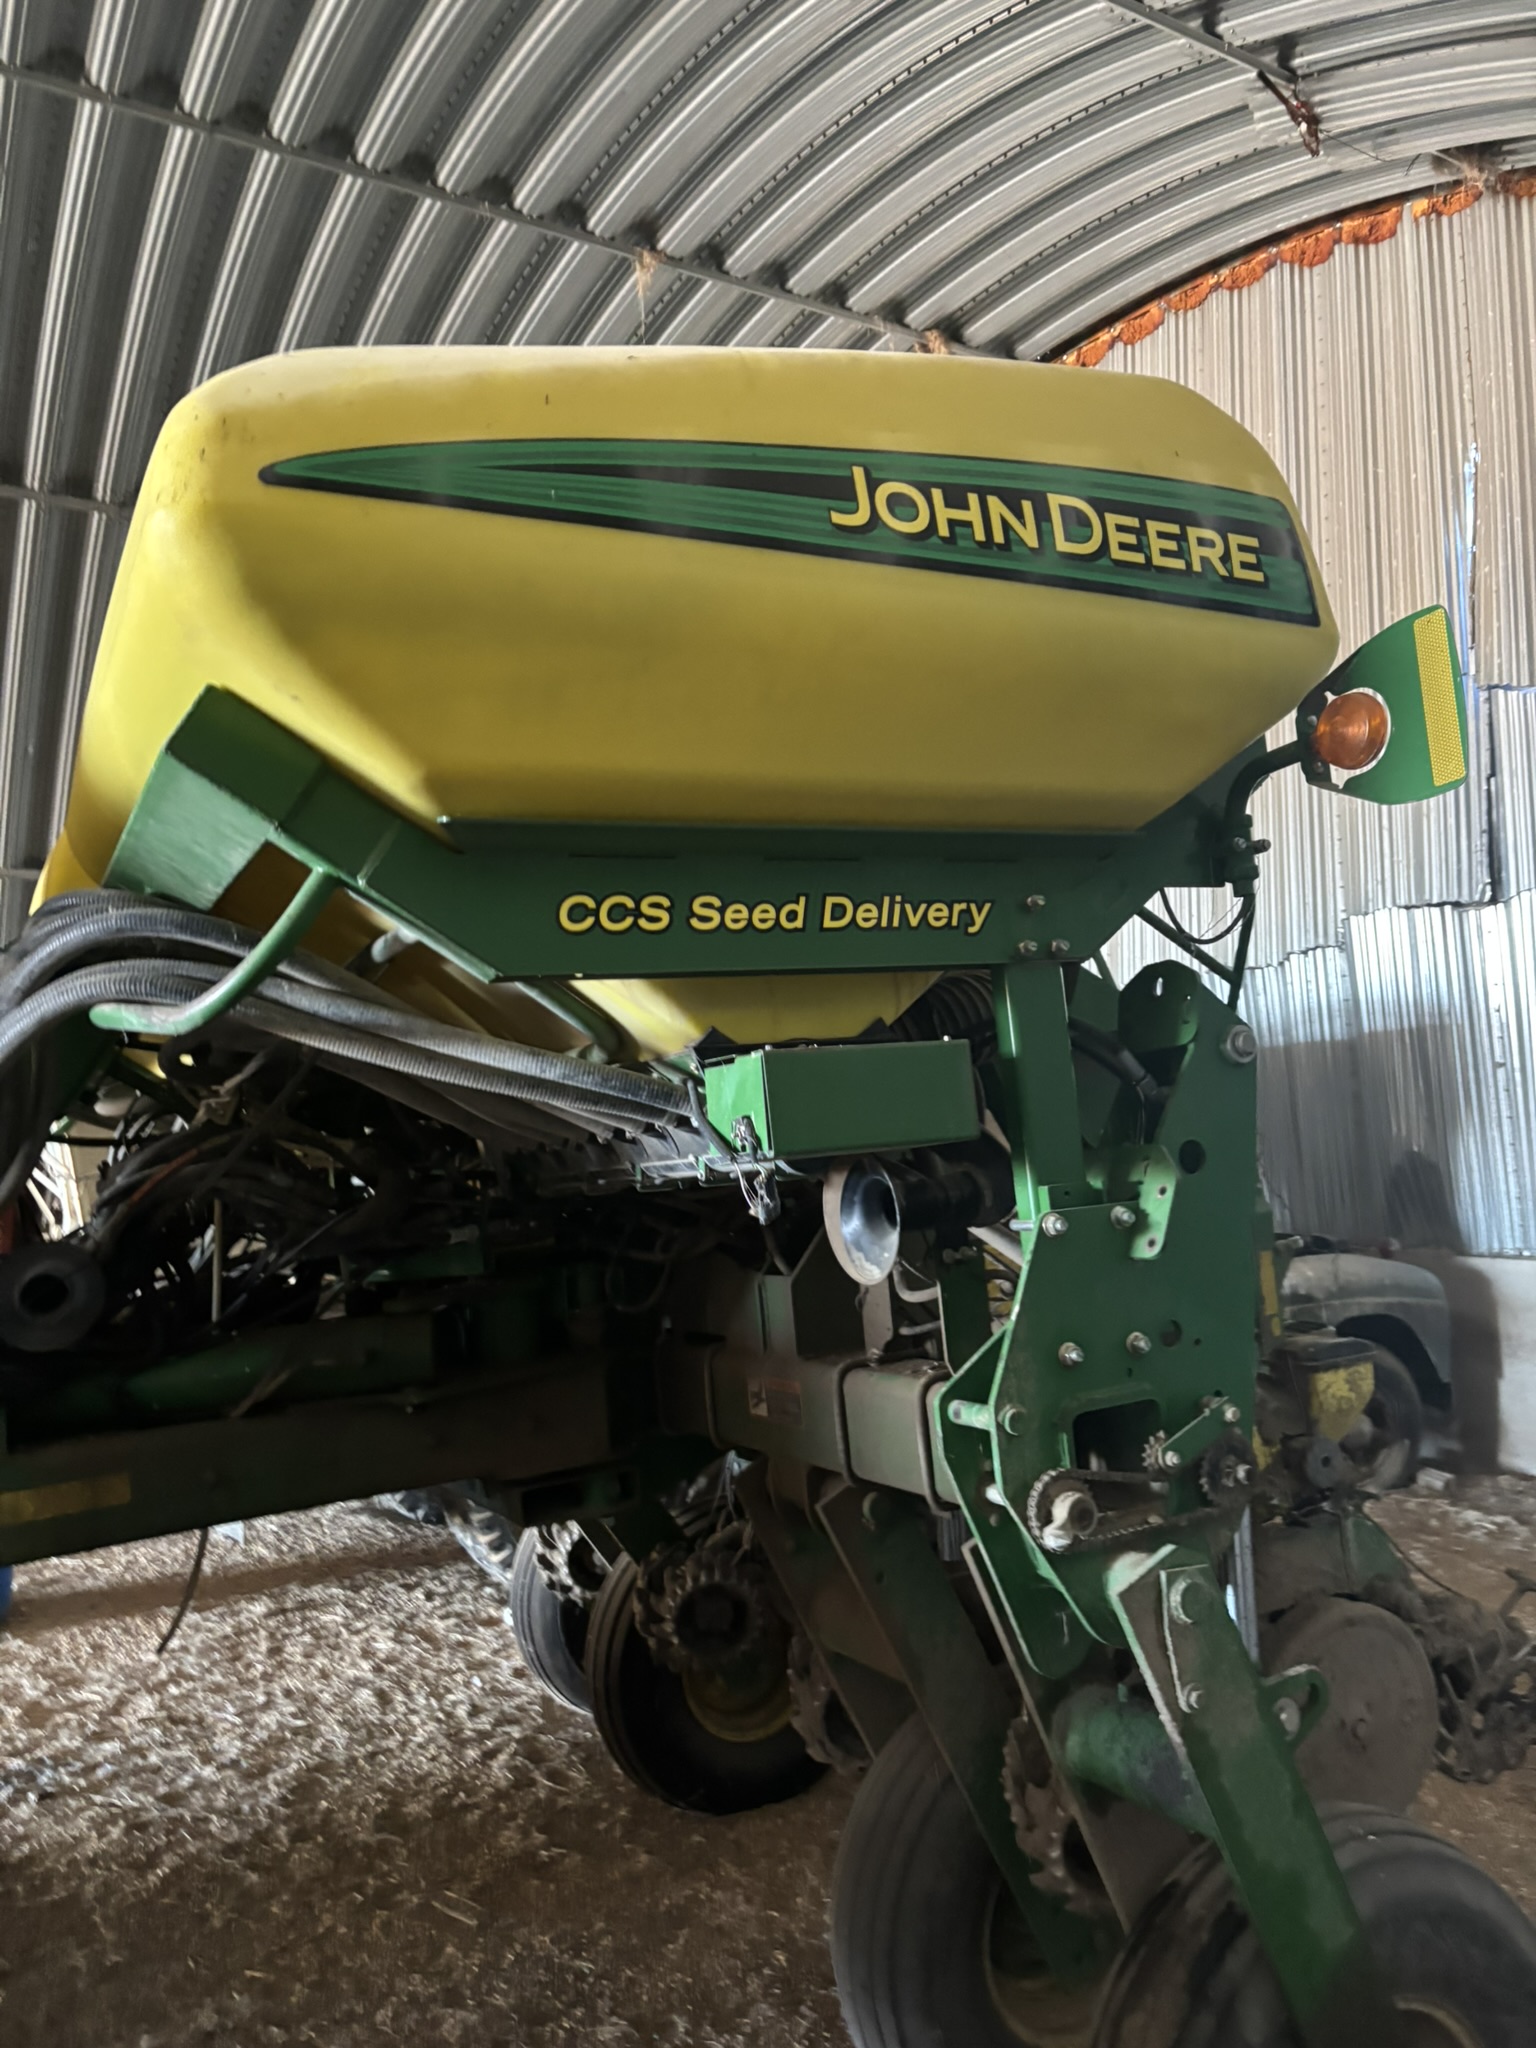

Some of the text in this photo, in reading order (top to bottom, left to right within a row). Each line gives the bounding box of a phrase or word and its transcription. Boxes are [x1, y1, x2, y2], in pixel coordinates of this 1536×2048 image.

[829, 465, 1266, 583] JOHN DEERE
[558, 894, 992, 934] CCS Seed Delivery
